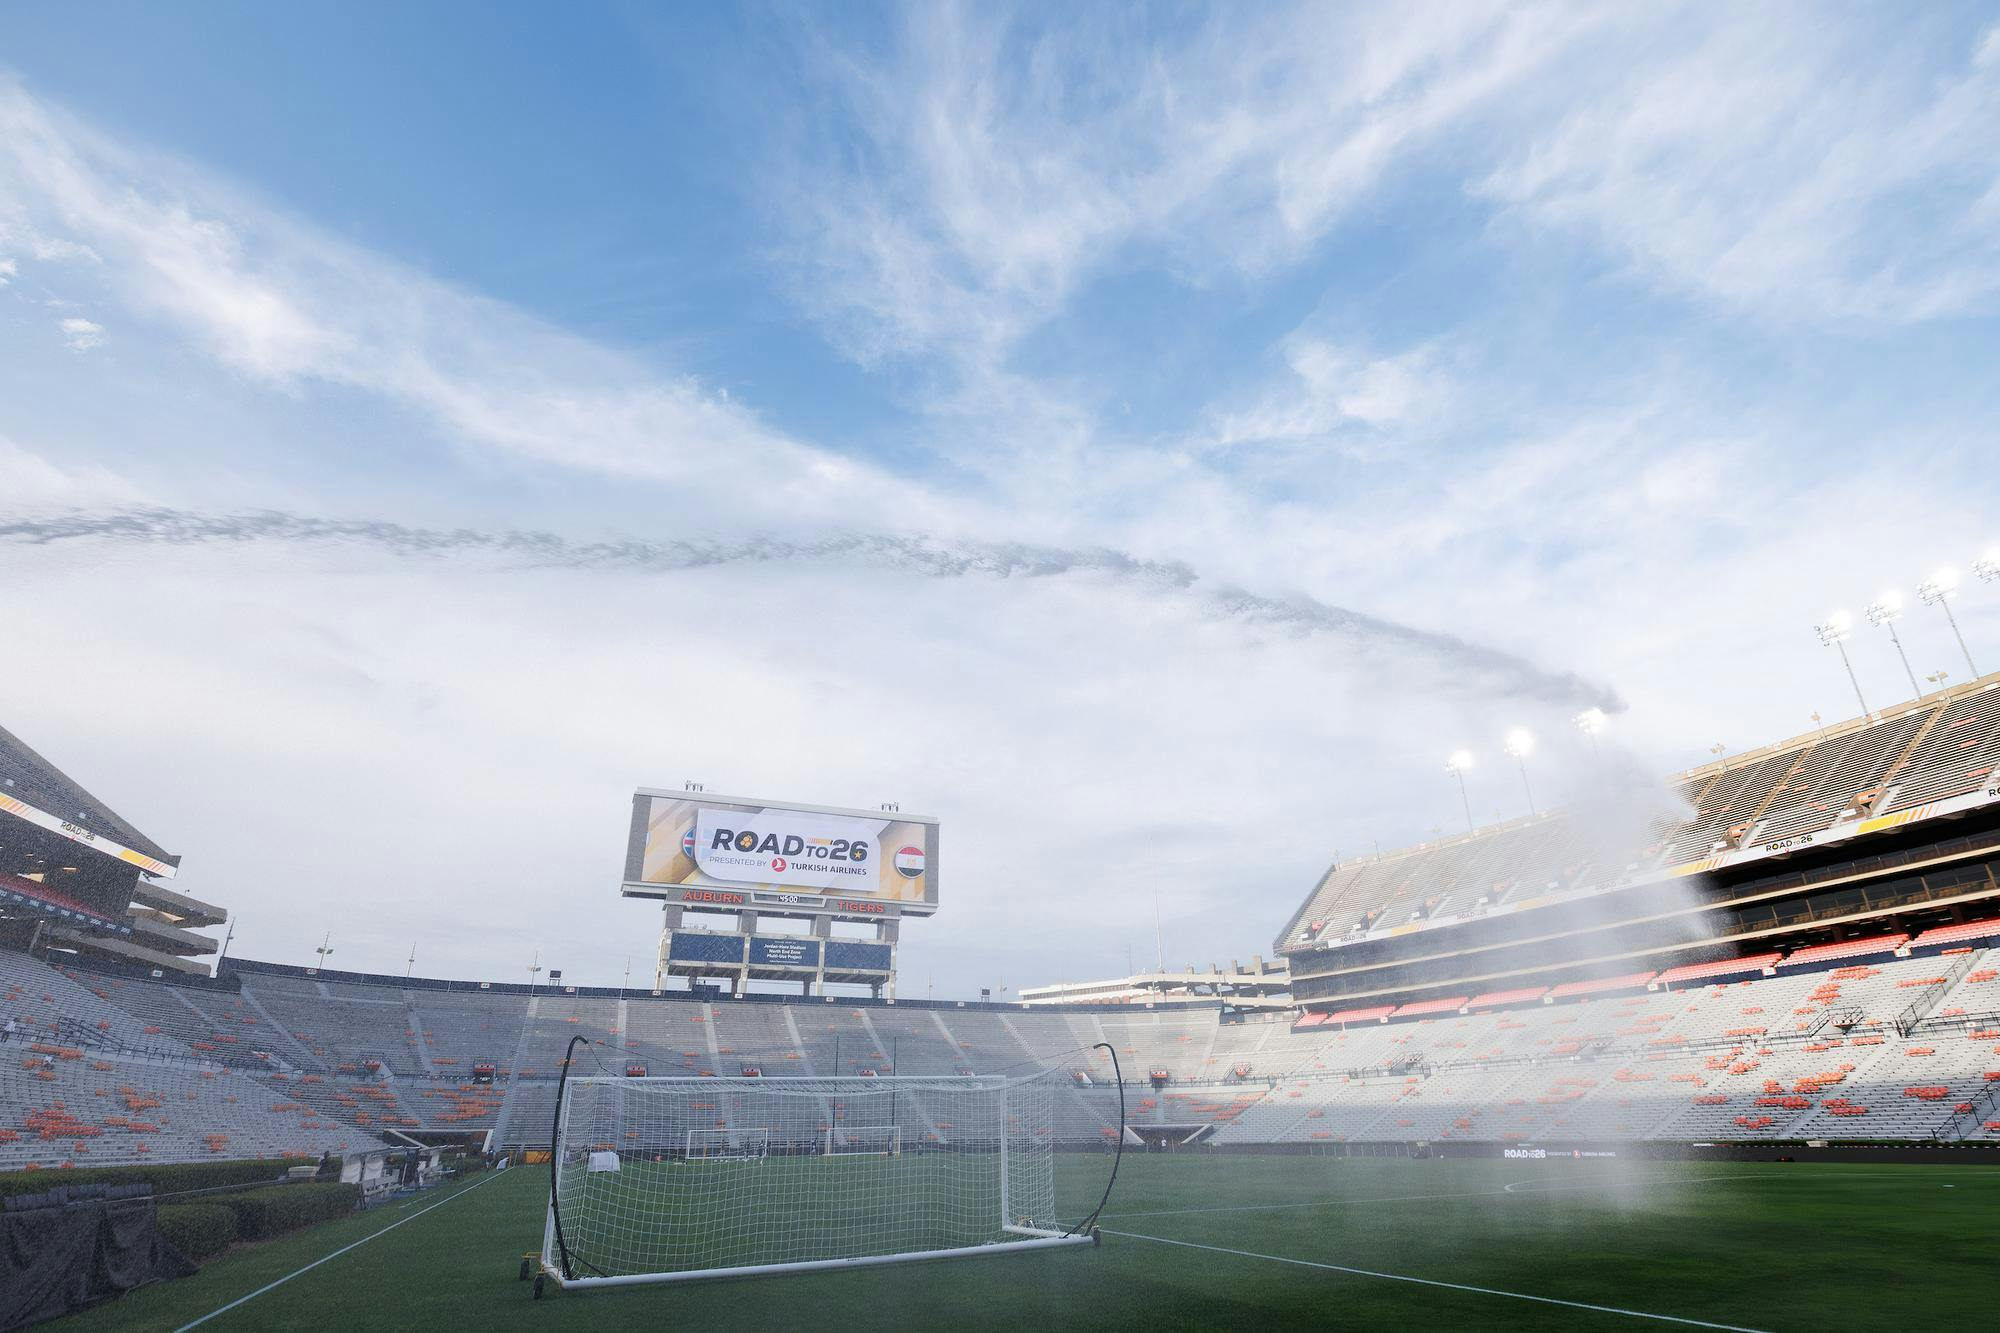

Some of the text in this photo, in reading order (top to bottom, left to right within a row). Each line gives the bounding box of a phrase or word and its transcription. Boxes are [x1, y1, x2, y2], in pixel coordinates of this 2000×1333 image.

[61, 821, 81, 835] ROAD
[711, 828, 805, 856] ROAD
[806, 845, 829, 859] TO
[1766, 840, 1793, 851] ROAD
[1800, 834, 1813, 844] 26
[709, 856, 867, 876] PRESENTED BY TURKISH AIRLINES
[684, 889, 743, 904] AUBURN
[838, 899, 885, 913] TIGERS
[1504, 1149, 1528, 1158] ROAD
[1535, 1149, 1546, 1158] 26
